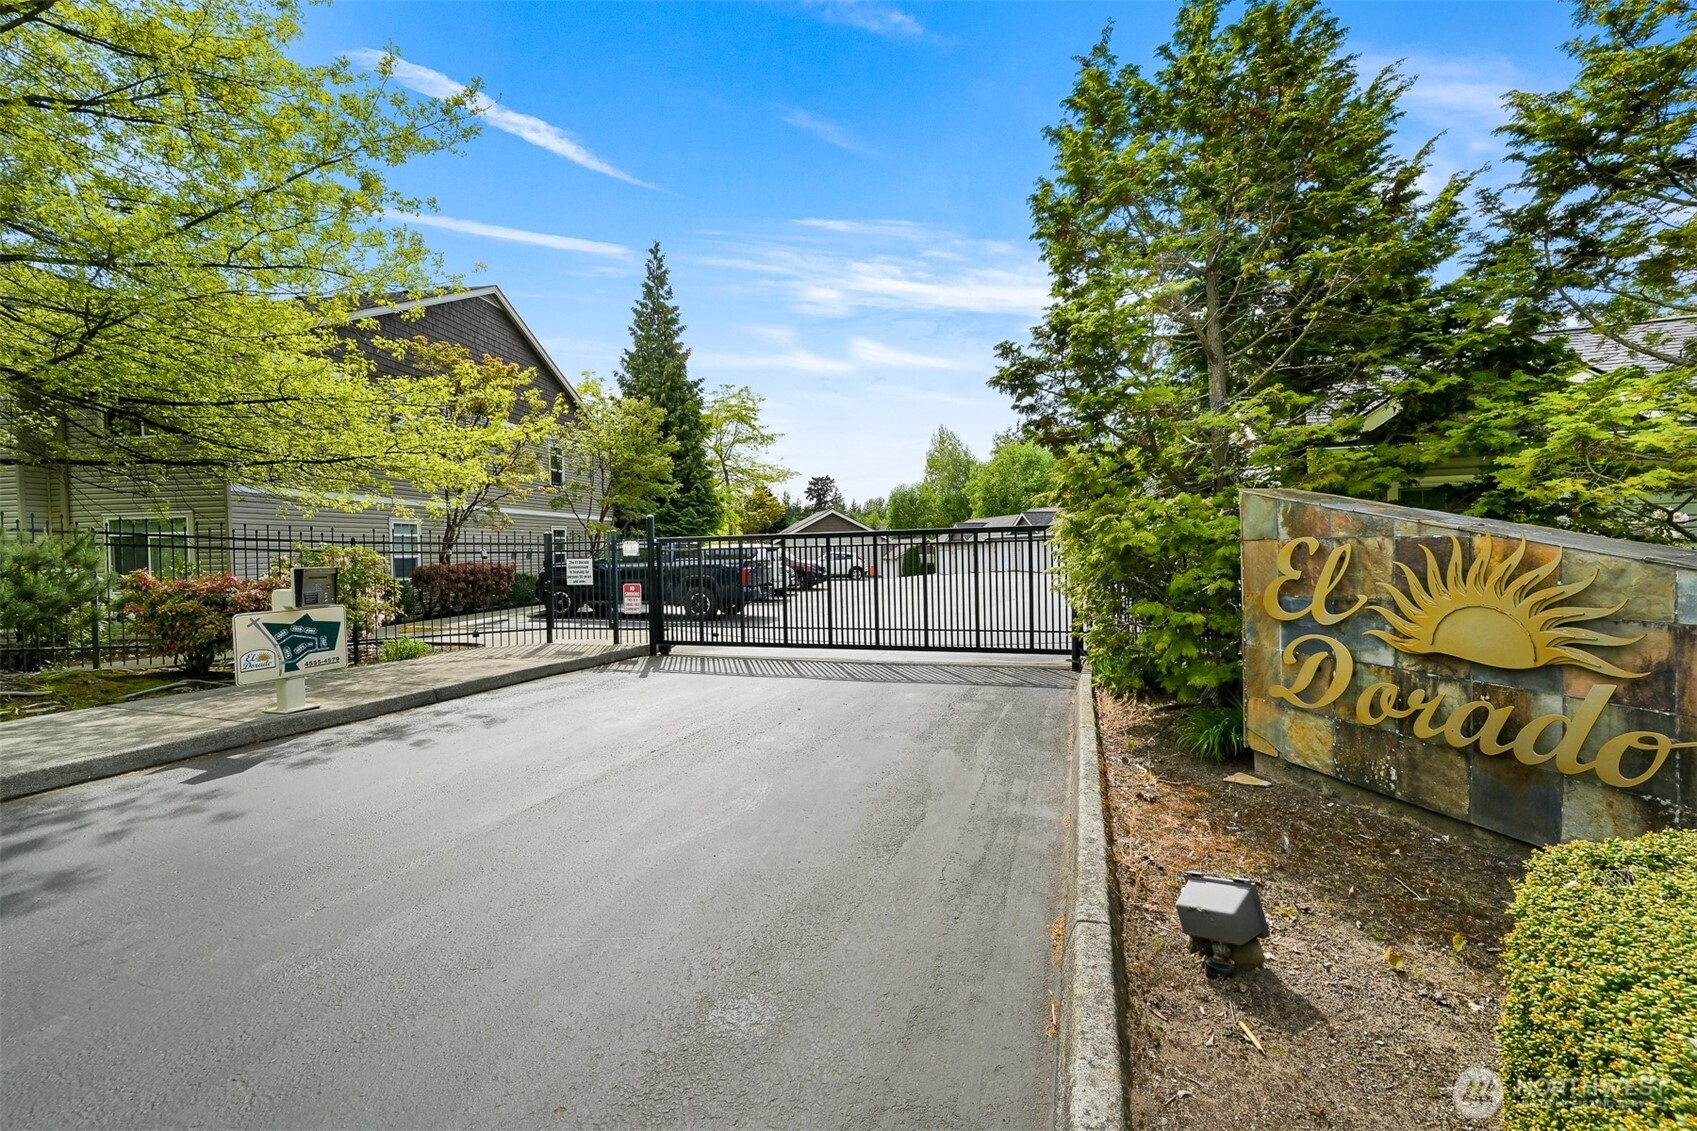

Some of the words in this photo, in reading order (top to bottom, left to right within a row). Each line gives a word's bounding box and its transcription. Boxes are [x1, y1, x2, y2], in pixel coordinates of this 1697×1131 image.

[1263, 536, 1368, 626] El
[246, 654, 256, 662] El
[304, 656, 340, 667] 4555-4579
[243, 660, 273, 670] Dorado
[1268, 633, 1697, 788] Dorado
